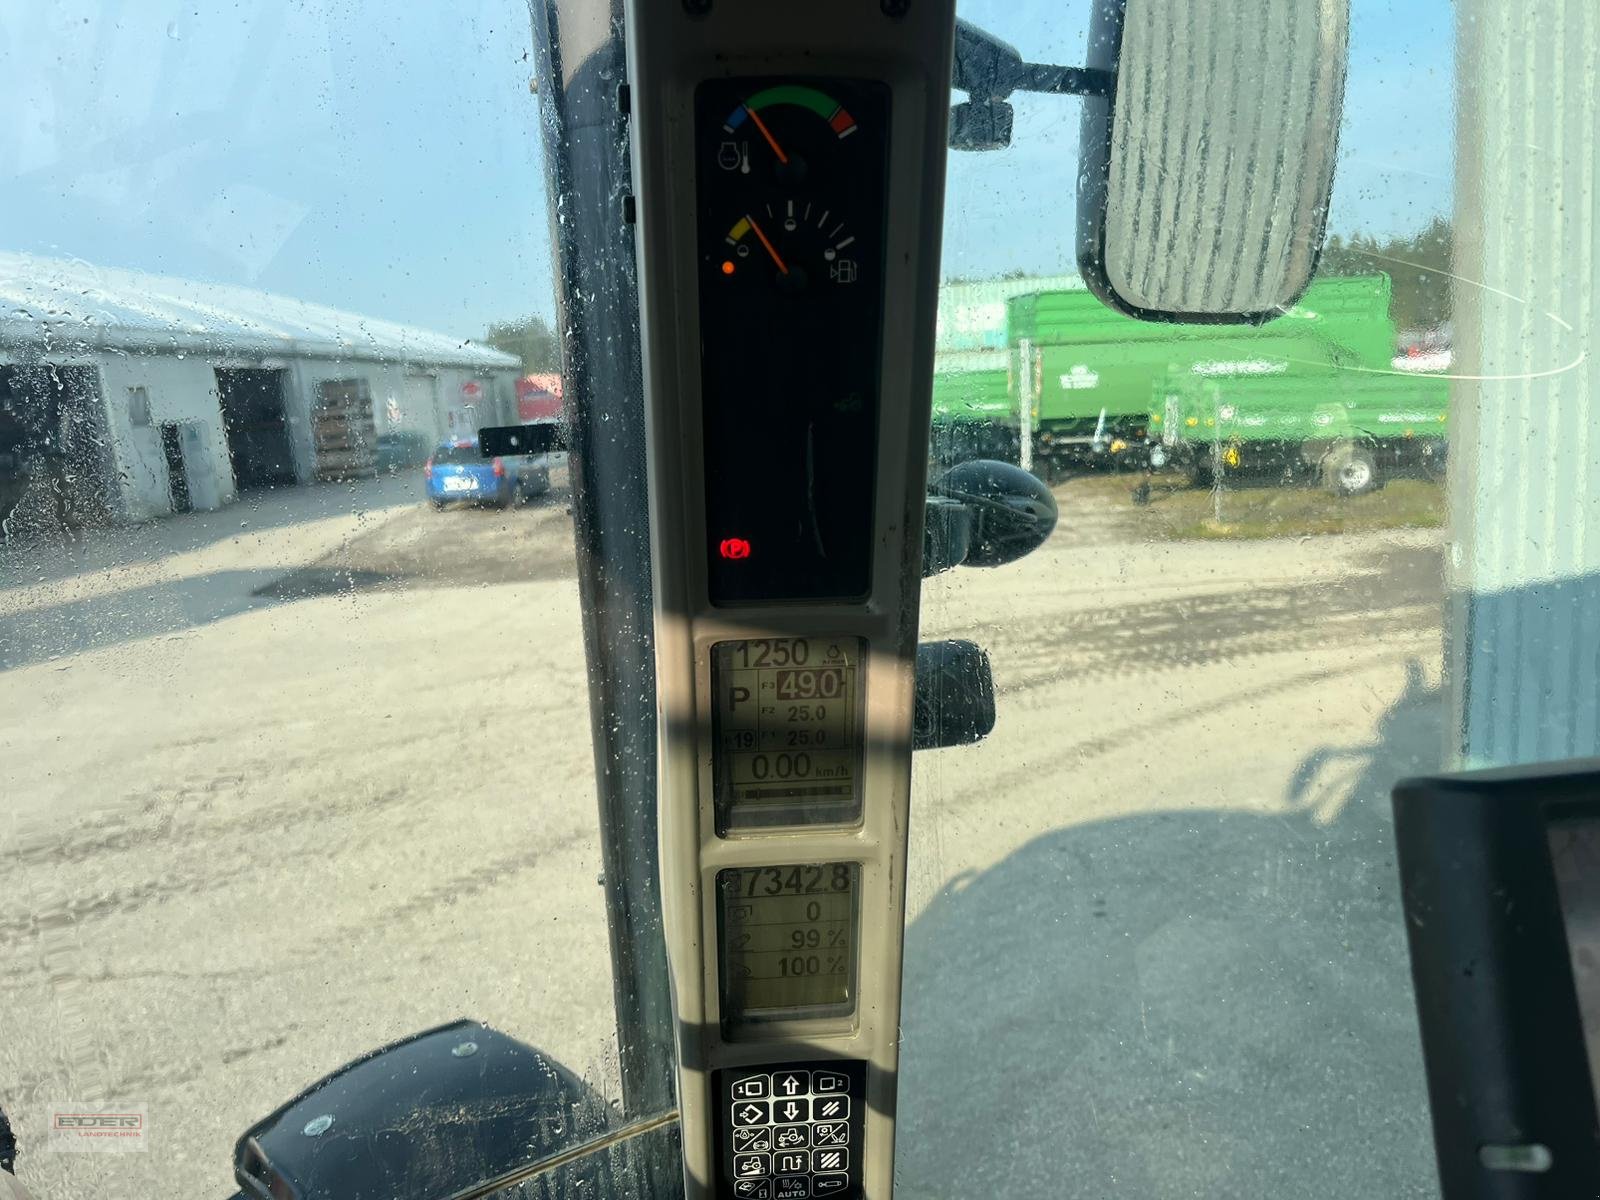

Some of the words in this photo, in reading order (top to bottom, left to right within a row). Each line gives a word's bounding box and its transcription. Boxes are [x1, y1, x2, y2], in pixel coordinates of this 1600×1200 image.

[736, 639, 809, 668] 1250
[779, 671, 838, 698] 49.0
[729, 686, 751, 712] P
[761, 707, 775, 715] F2
[788, 705, 826, 722] 25.0
[788, 729, 826, 746] 25.0
[752, 752, 811, 779] 0.00
[815, 765, 848, 778] km/h
[746, 864, 850, 896] 7342.8
[806, 901, 821, 921] 0
[791, 929, 820, 949] 99
[828, 929, 846, 946] %
[778, 956, 820, 977] 100
[828, 956, 846, 973] %
[738, 1085, 744, 1094] 1
[837, 1079, 843, 1087] 2
[777, 1190, 806, 1198] AUTO
